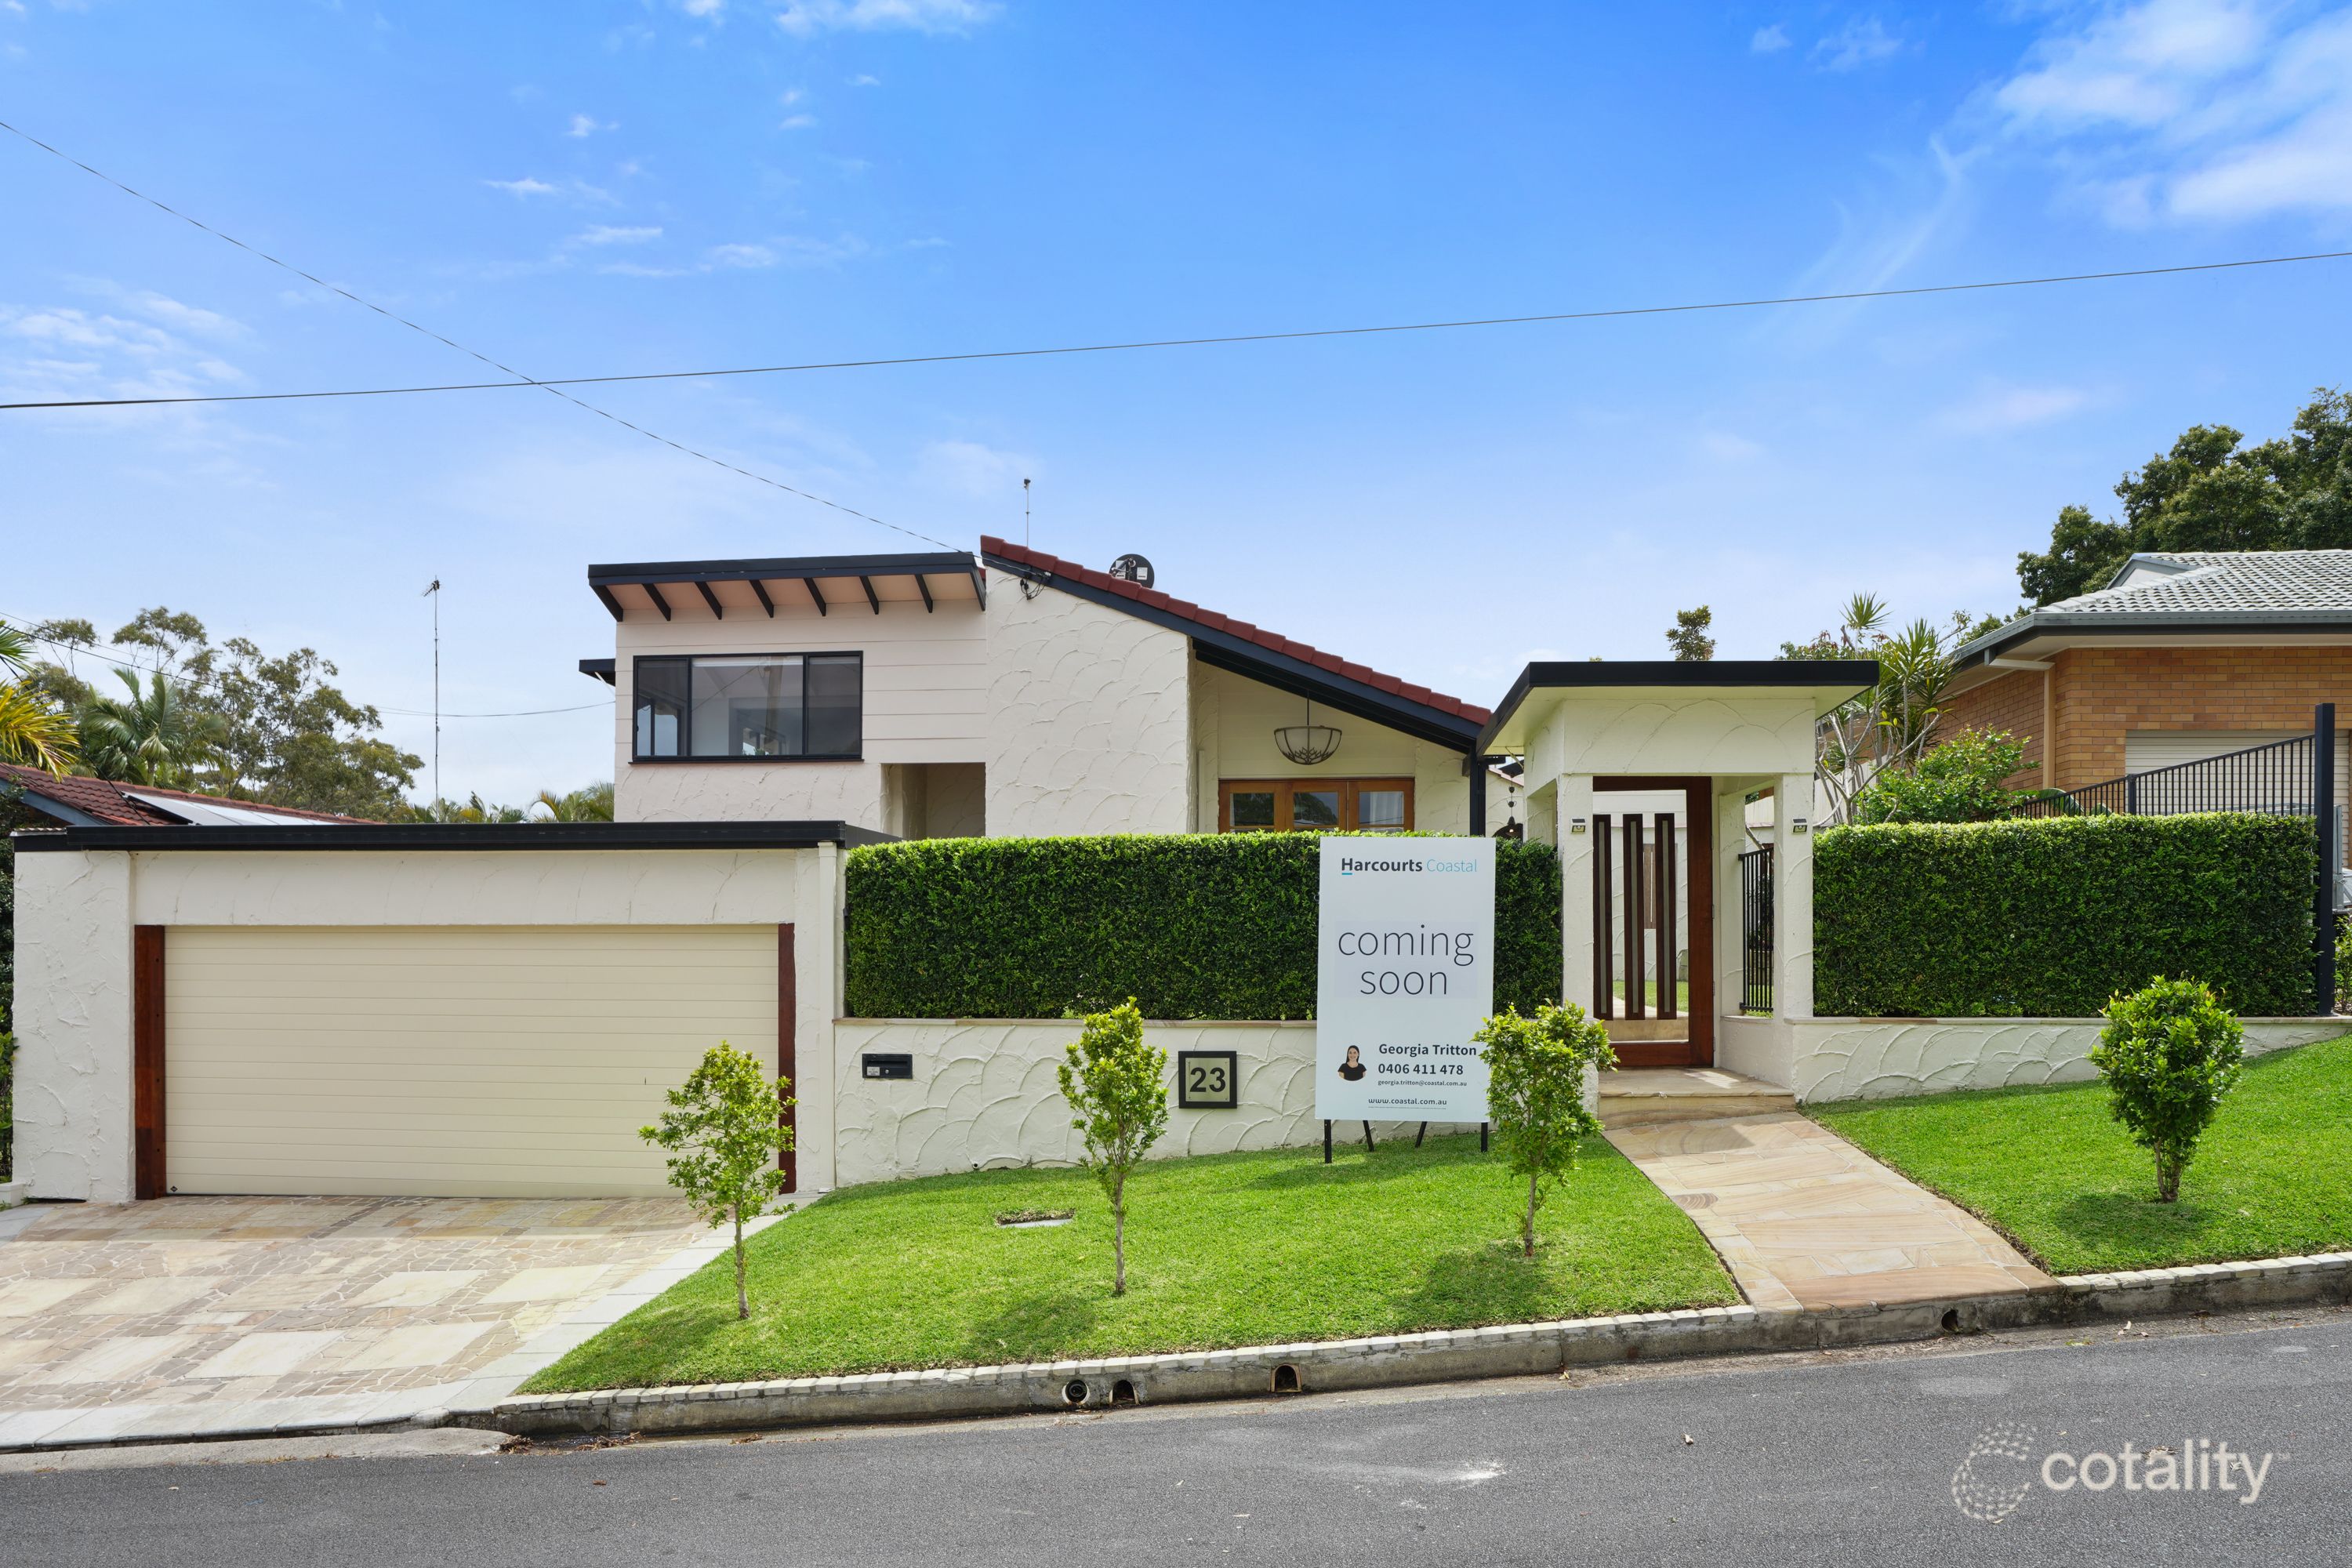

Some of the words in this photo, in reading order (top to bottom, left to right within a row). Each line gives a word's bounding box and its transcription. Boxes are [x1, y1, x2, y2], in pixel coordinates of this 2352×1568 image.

[1341, 858, 1423, 872] Harcourts
[1426, 859, 1477, 873] Coastal
[1338, 924, 1474, 966] coming
[1360, 971, 1447, 995] soon
[1378, 1044, 1429, 1058] Georgia
[1432, 1044, 1477, 1056] Tritton
[1377, 1063, 1410, 1074] 0406
[1413, 1064, 1436, 1075] 411
[1439, 1065, 1464, 1075] 478
[1189, 1067, 1226, 1093] 23
